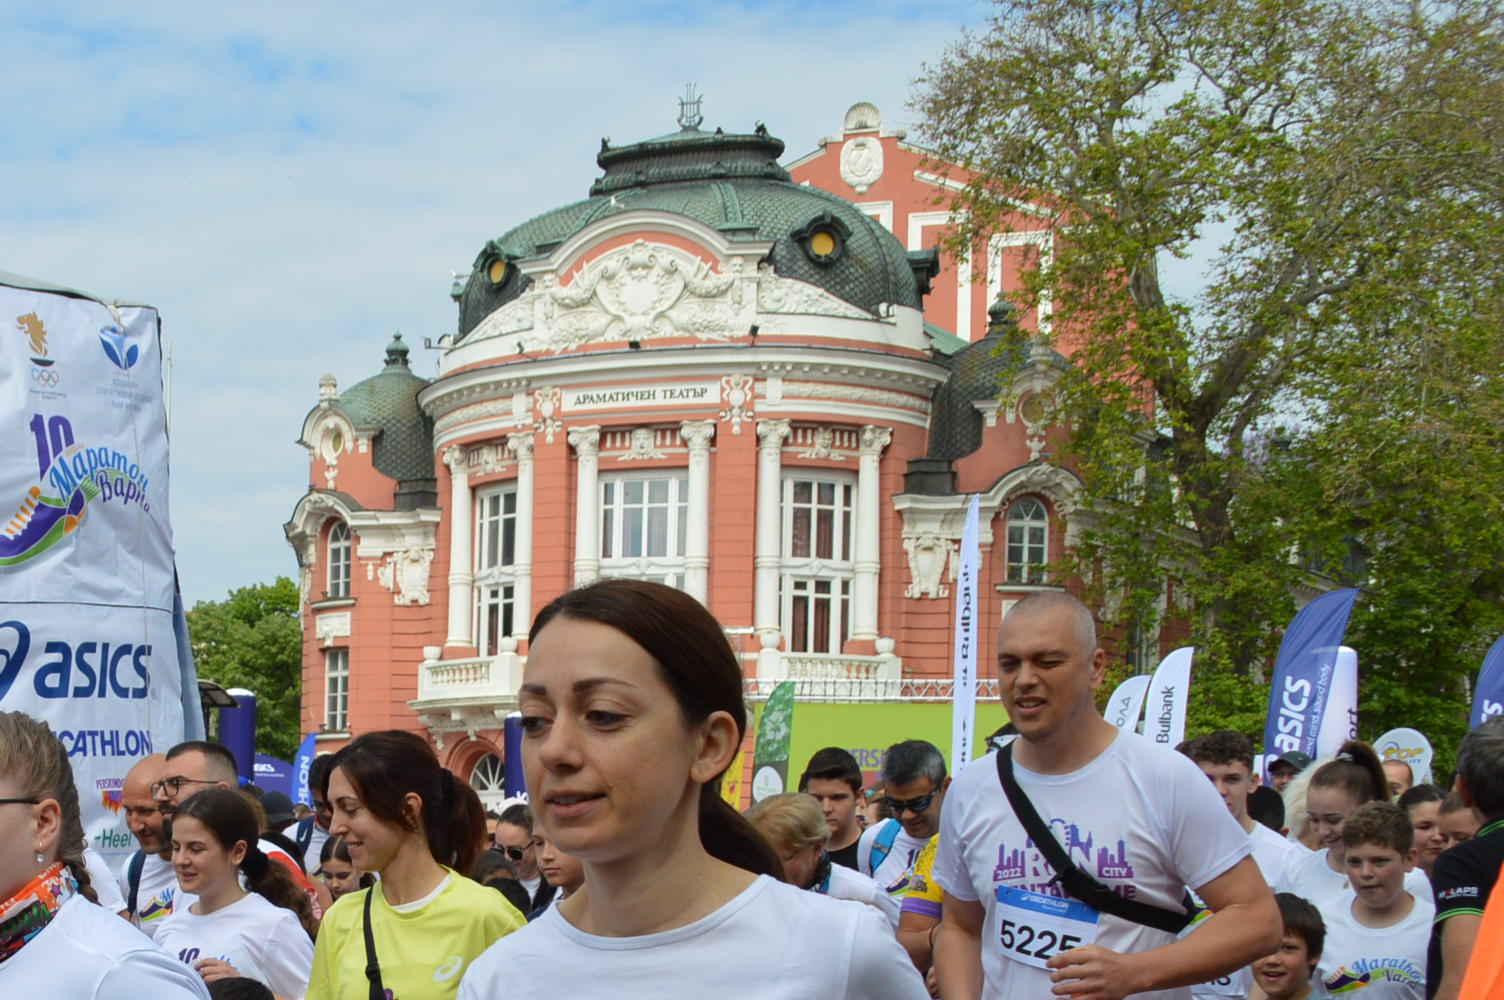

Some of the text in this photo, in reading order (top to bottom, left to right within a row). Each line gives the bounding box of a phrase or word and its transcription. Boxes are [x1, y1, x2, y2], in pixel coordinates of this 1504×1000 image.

[574, 387, 708, 406] ДРАМАТИЧЕН ТЕАТЪР
[49, 447, 149, 504] Маратон
[1155, 685, 1175, 744] Bulbank
[1273, 676, 1312, 755] asics
[53, 729, 154, 758] CATHLON
[997, 867, 1022, 879] 2022
[1102, 866, 1128, 877] CITY
[1352, 957, 1422, 983] Marathon
